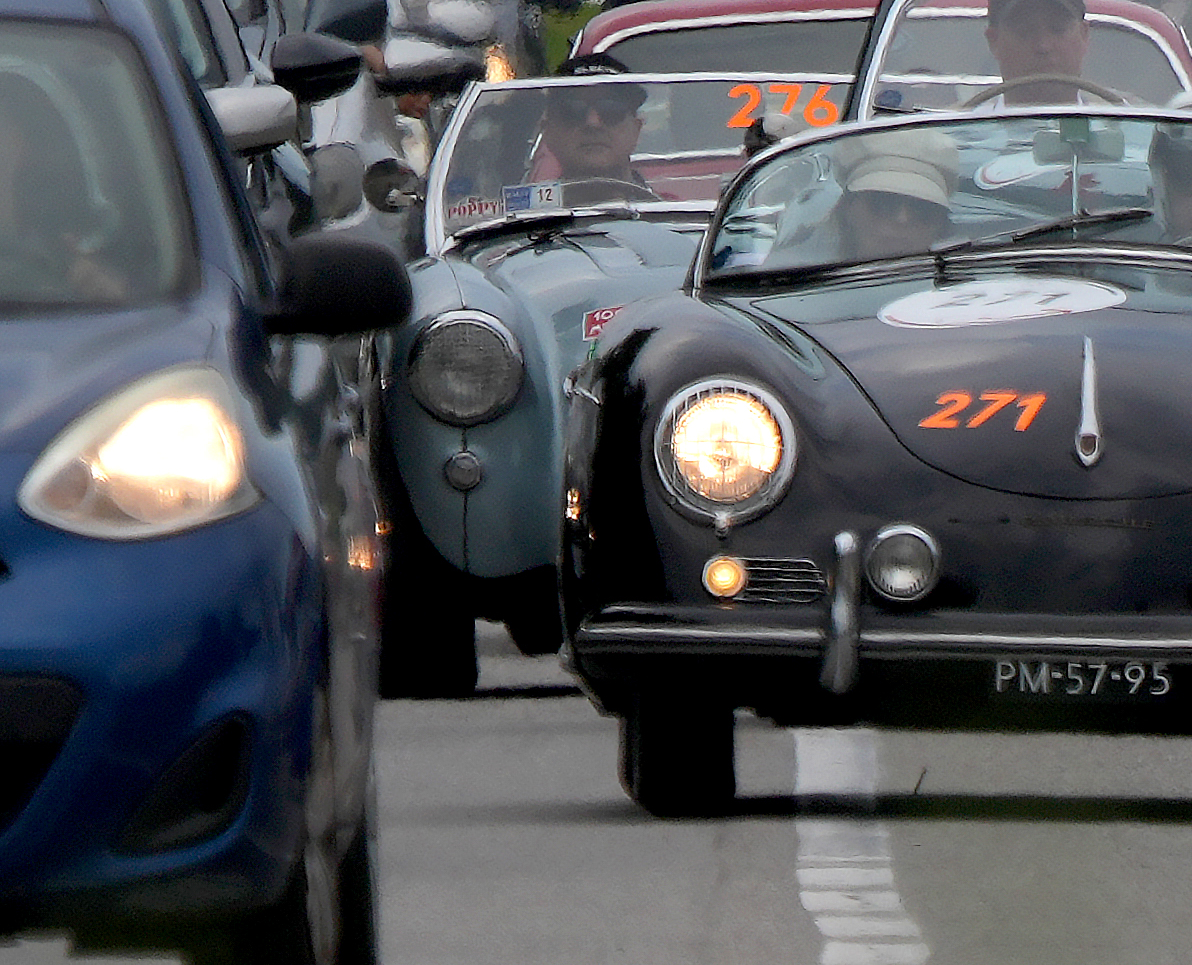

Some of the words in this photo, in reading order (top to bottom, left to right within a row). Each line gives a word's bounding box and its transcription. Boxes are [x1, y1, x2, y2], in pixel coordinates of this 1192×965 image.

[727, 83, 839, 128] 276
[537, 188, 553, 203] 12
[917, 389, 1046, 432] 271
[996, 662, 1171, 695] PM-57-95
